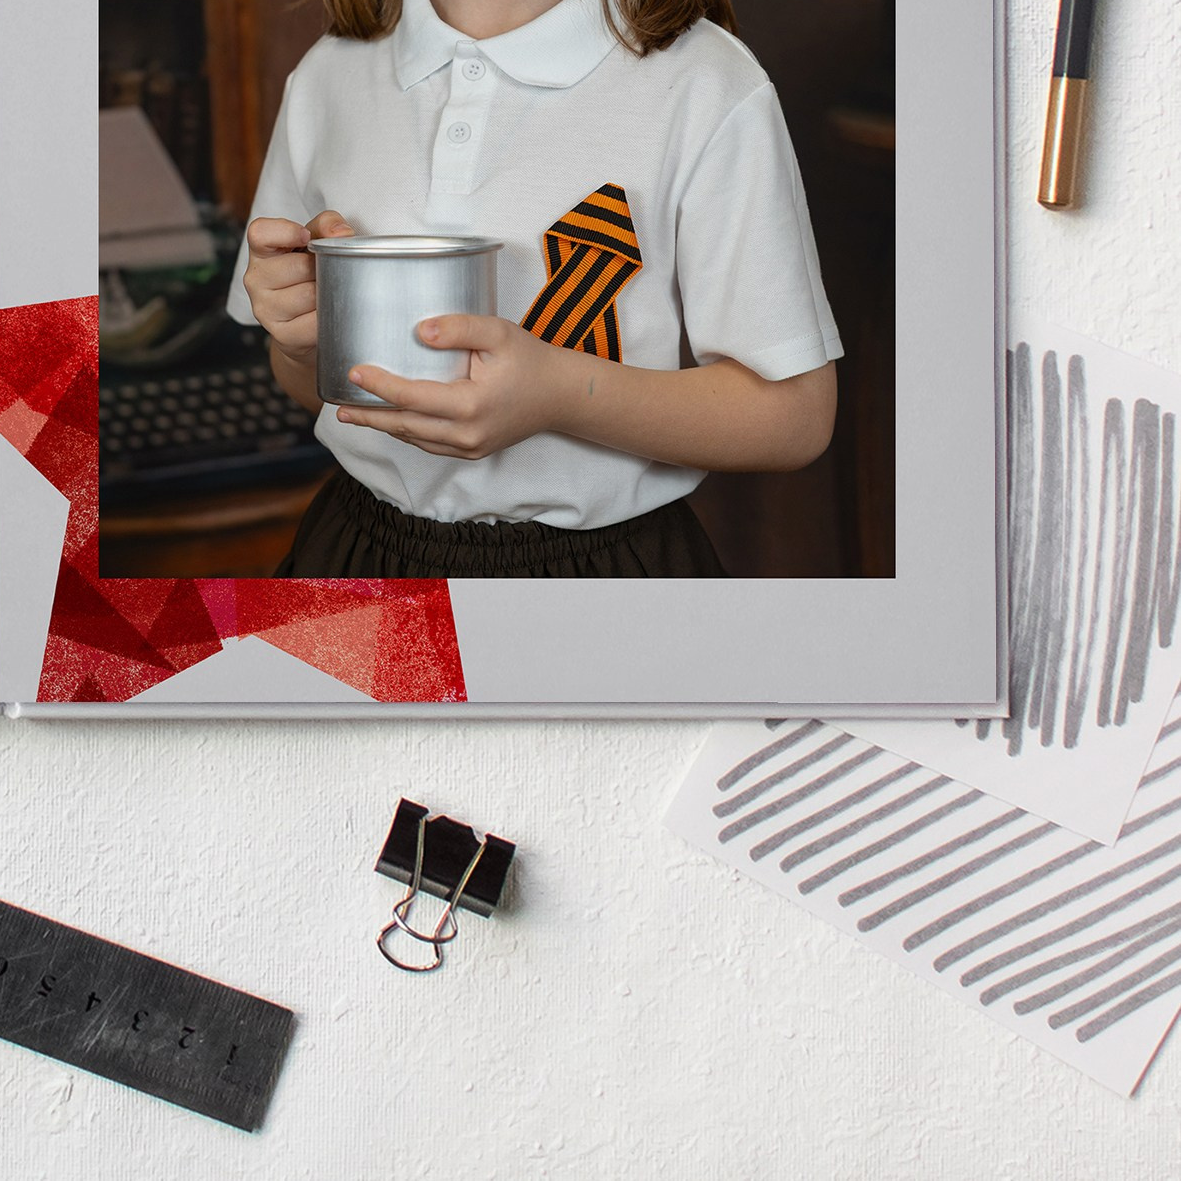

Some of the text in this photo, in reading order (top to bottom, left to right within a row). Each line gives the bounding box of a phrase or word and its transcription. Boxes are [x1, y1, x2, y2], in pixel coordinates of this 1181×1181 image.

[36, 975, 57, 998] 5
[85, 991, 102, 1013] 4
[131, 1010, 149, 1032] 3
[178, 1026, 196, 1050] 2
